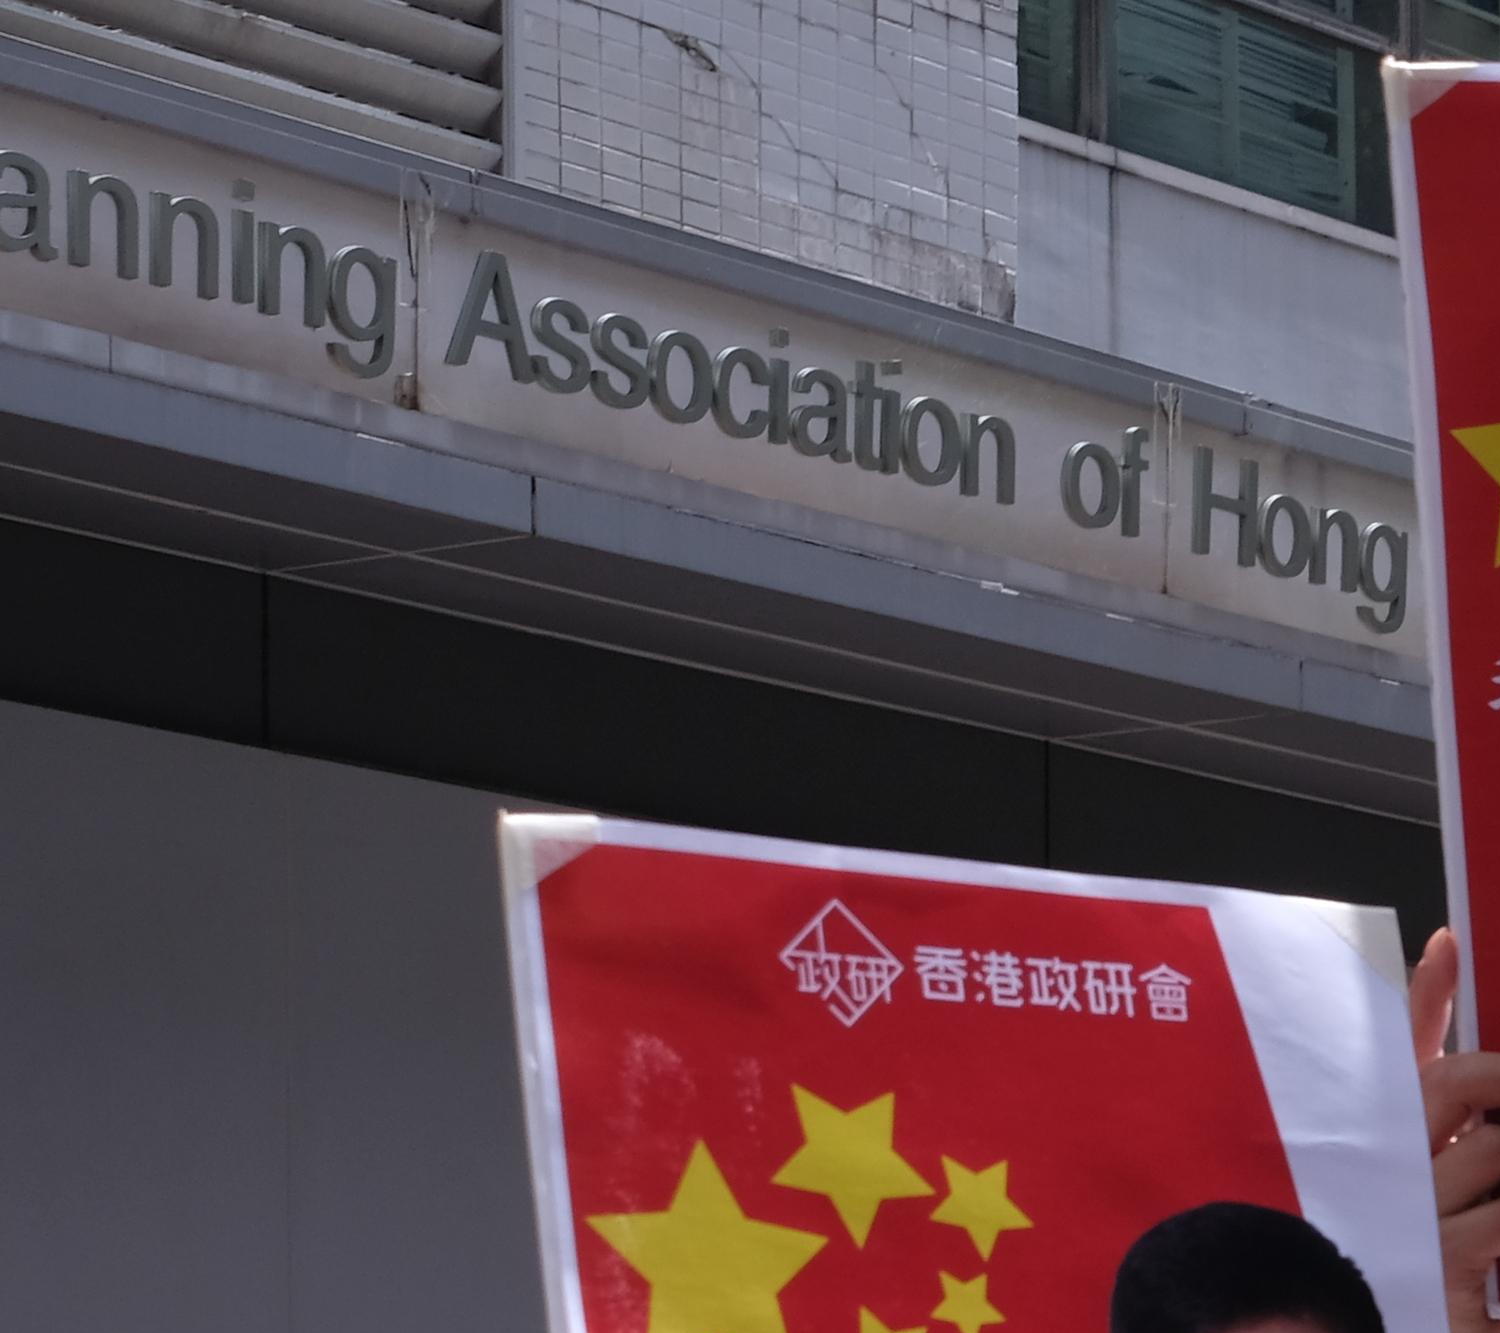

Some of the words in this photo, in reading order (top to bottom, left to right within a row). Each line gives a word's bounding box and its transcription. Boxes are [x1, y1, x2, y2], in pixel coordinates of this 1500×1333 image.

[444, 250, 1016, 506] Association
[1060, 425, 1149, 540] of
[1190, 445, 1410, 634] Hong
[912, 944, 1193, 1023] 香港政研會
